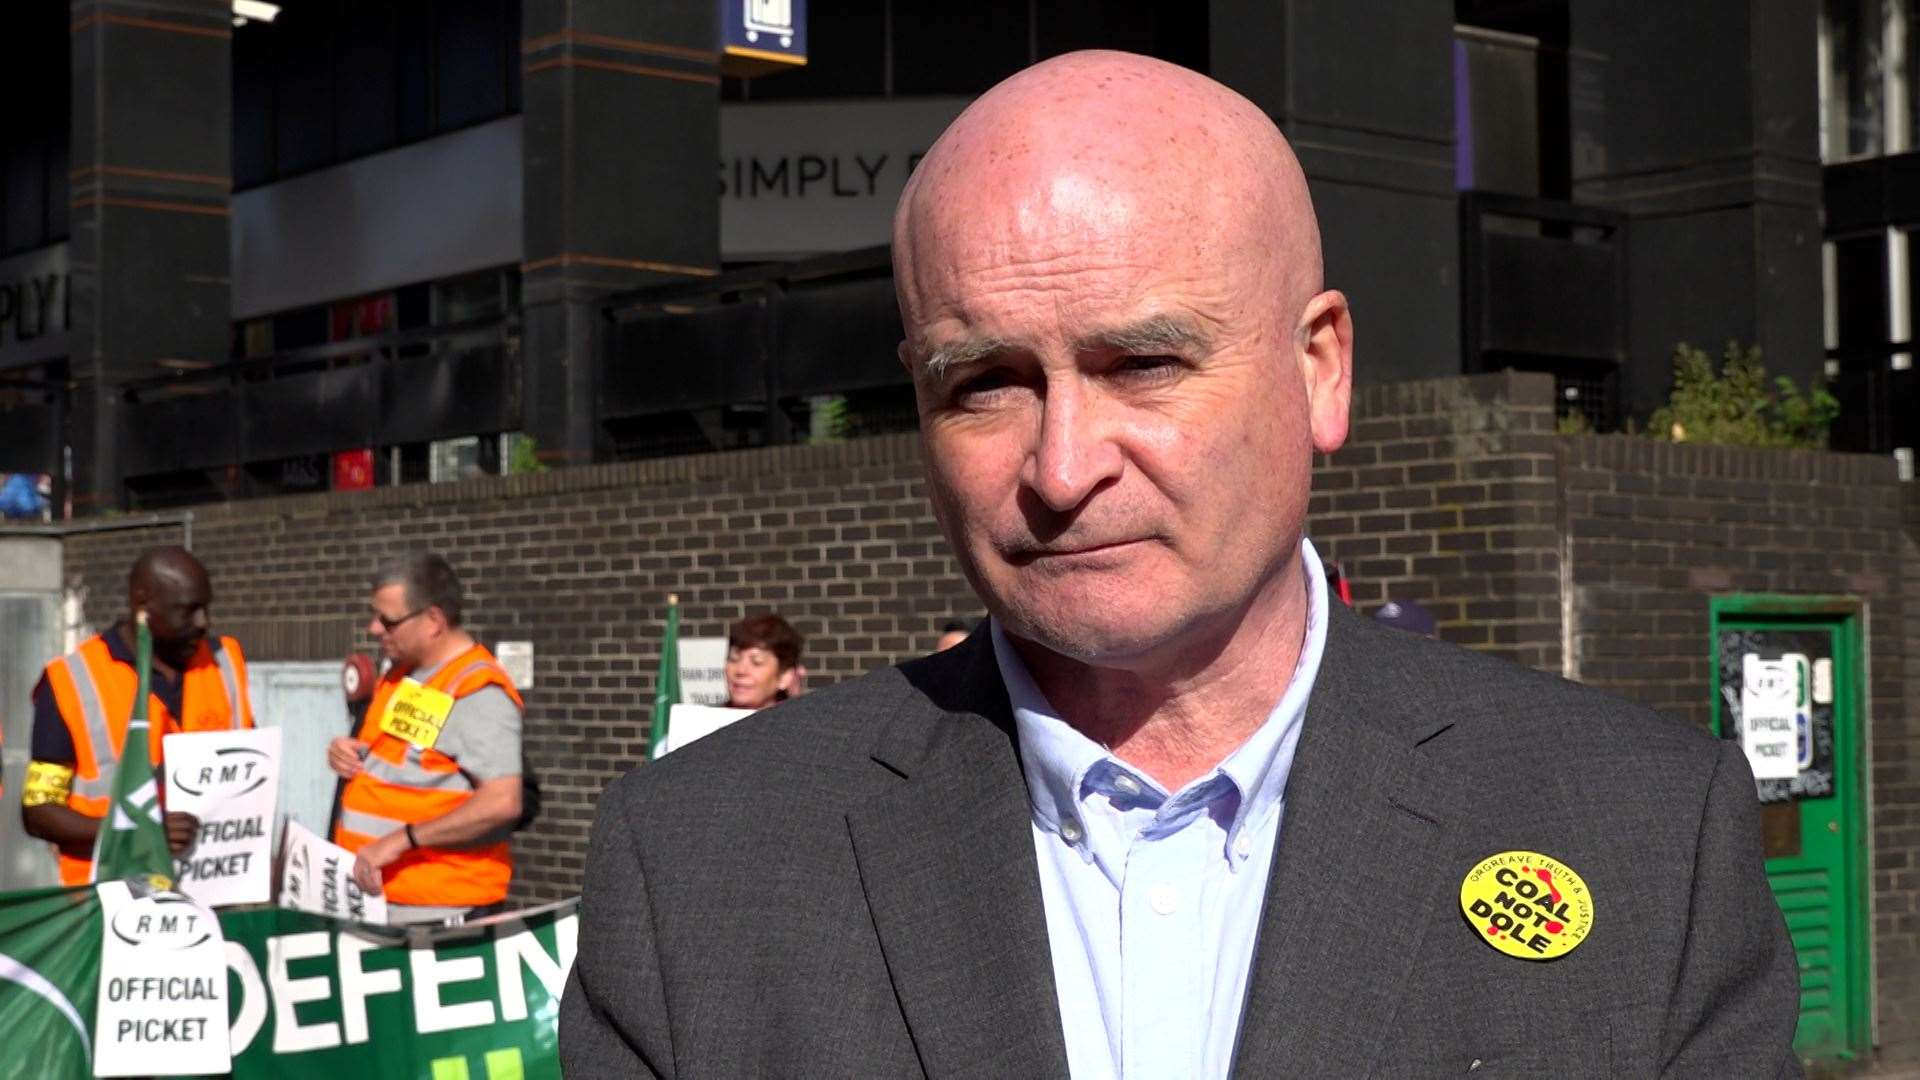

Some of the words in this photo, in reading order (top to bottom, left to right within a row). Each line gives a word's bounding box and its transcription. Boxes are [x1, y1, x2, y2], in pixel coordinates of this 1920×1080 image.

[199, 762, 256, 784] RMT
[200, 815, 265, 845] FICIAL
[177, 852, 253, 884] PICKET
[1470, 855, 1533, 882] ORGREAVE
[1539, 859, 1576, 886] TRUTH
[1571, 899, 1590, 940] JUSTICE
[1494, 891, 1551, 928] NOT
[1495, 867, 1571, 924] COAL
[136, 915, 199, 934] RMT
[1469, 898, 1552, 954] DOLE
[108, 977, 219, 1002] OFFICIAL
[117, 1017, 207, 1042] PICKET
